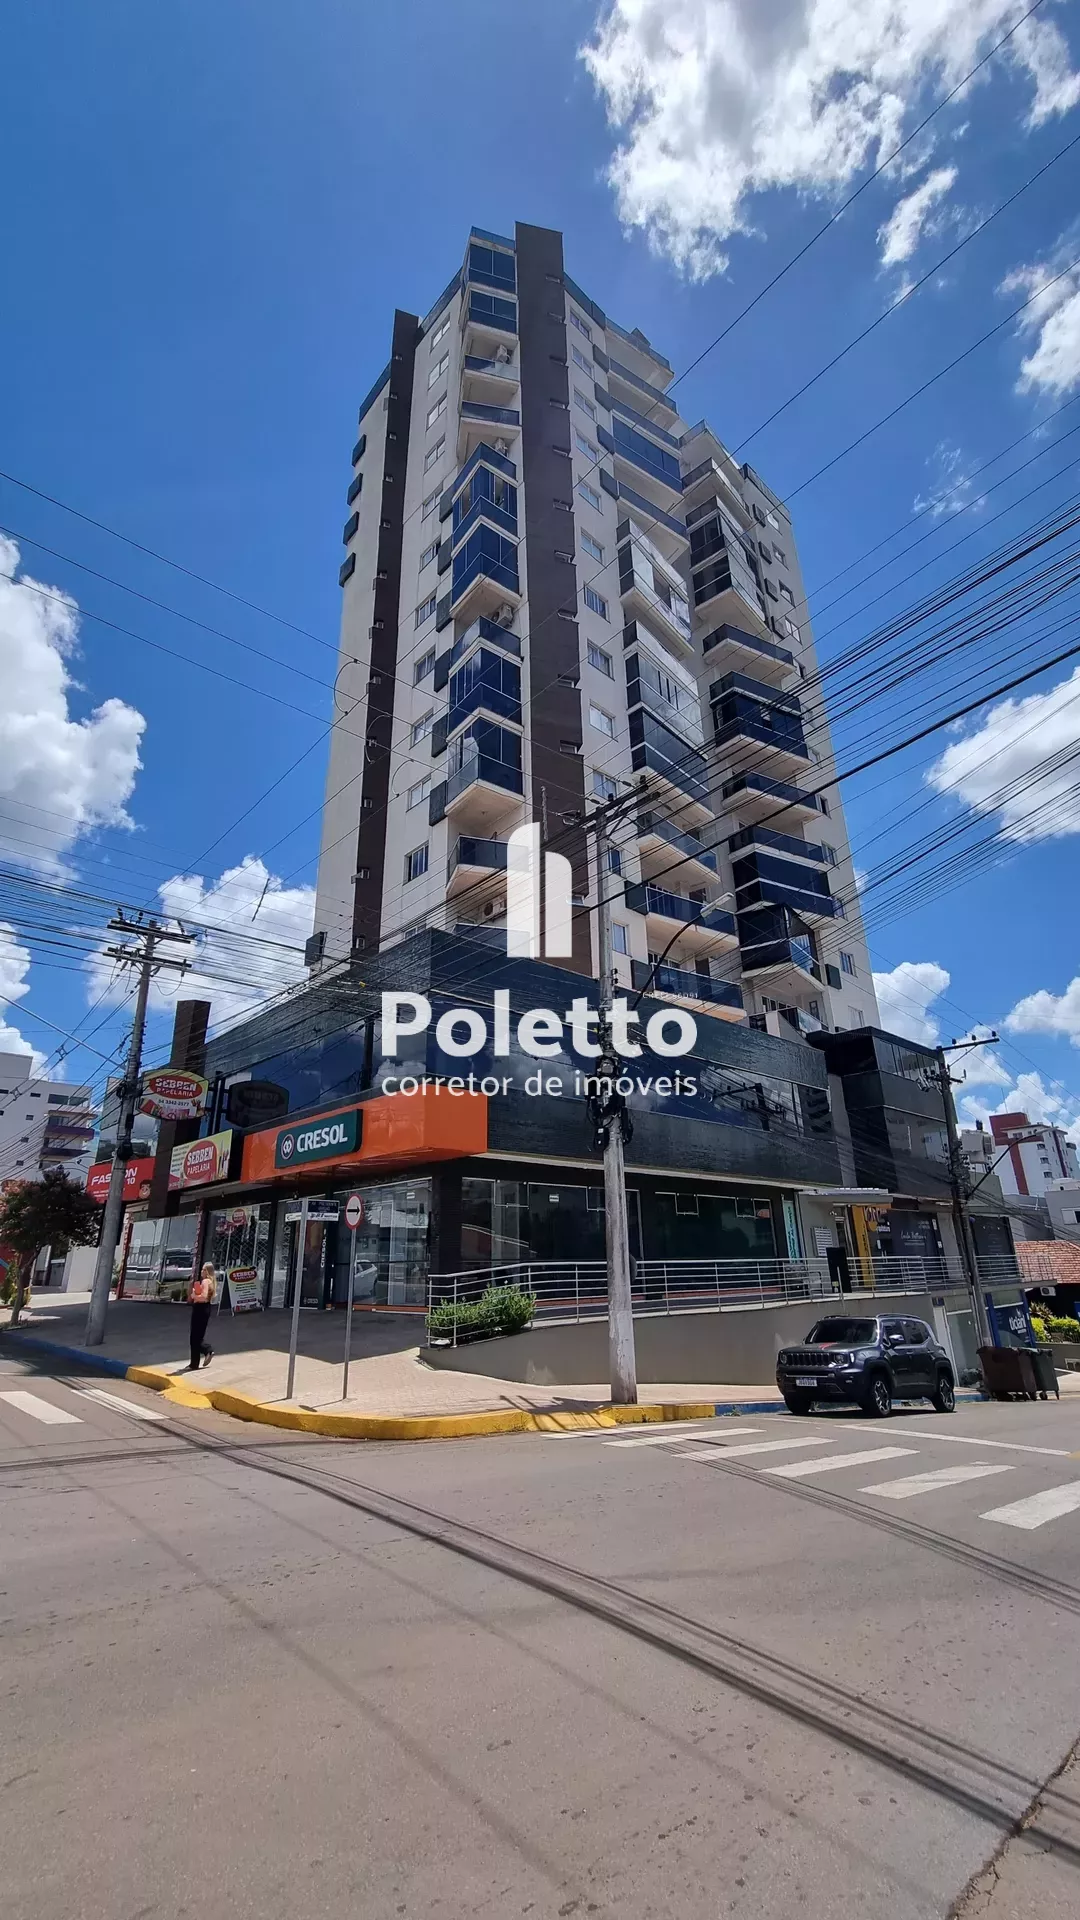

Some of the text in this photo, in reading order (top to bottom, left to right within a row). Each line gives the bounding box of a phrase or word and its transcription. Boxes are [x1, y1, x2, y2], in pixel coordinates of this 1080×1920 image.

[155, 1078, 198, 1092] SEBBEN
[156, 1087, 194, 1098] PAPELARIA
[296, 1123, 348, 1153] CRESOL
[187, 1146, 215, 1166] SEBBEN
[187, 1162, 211, 1176] PAPELARIA
[127, 1177, 136, 1186] 10
